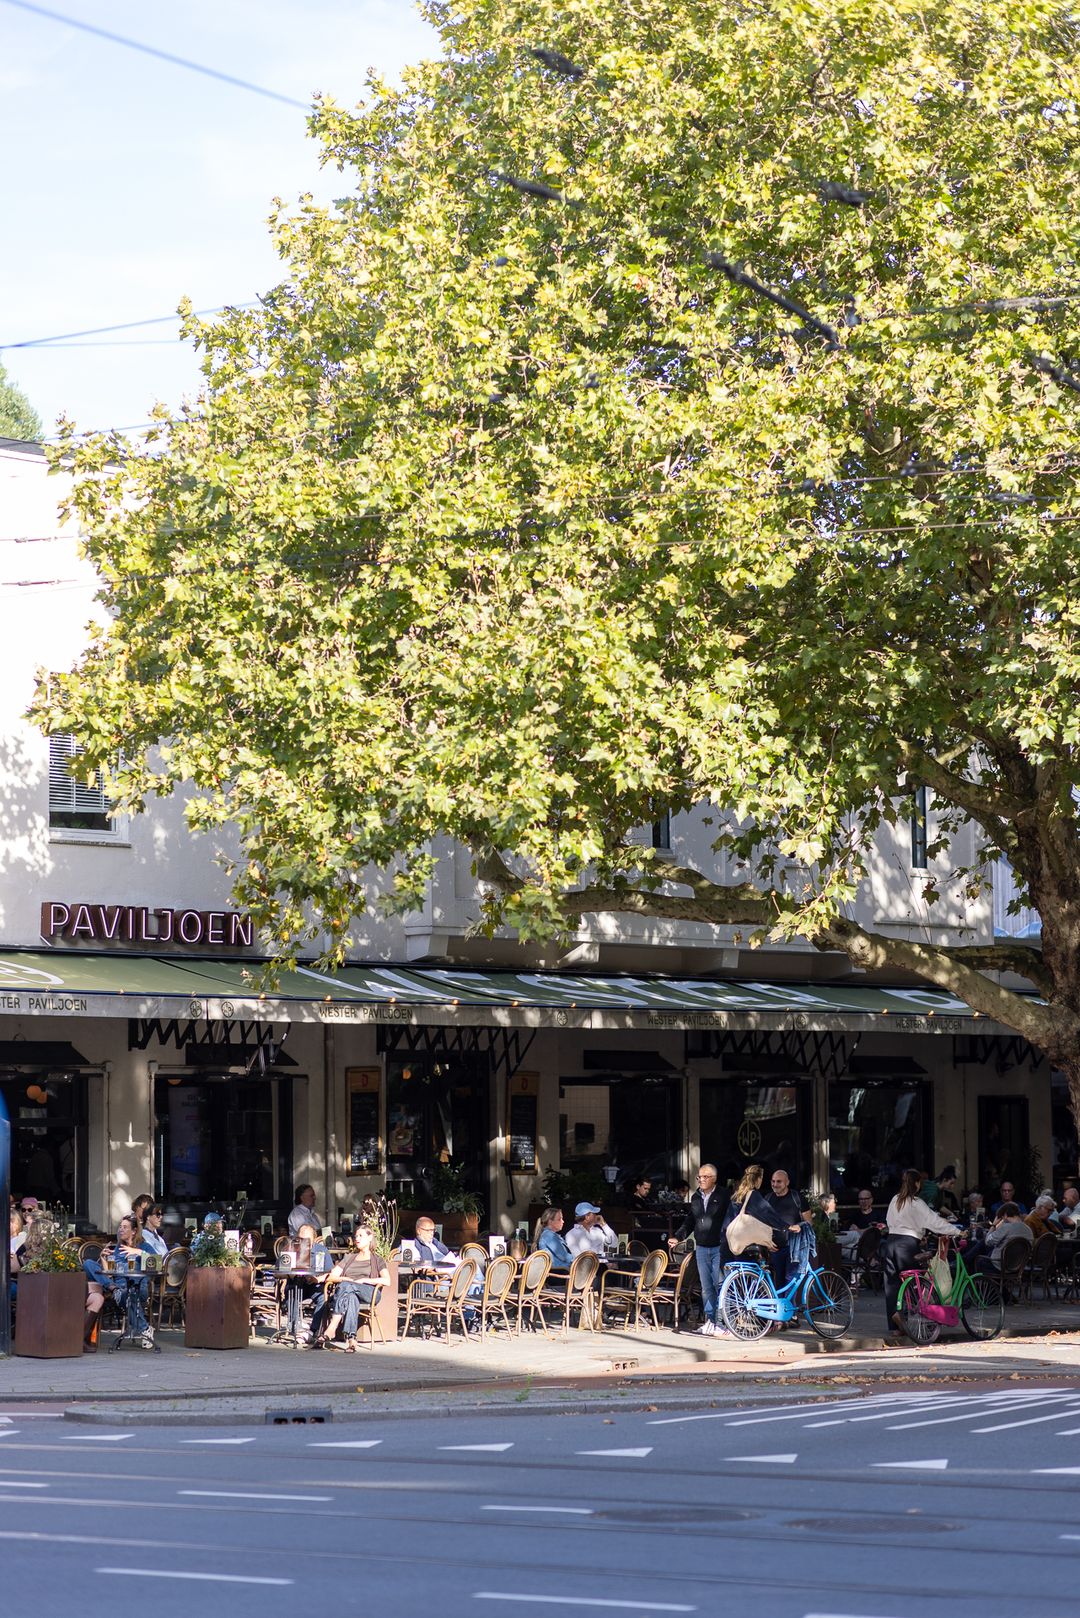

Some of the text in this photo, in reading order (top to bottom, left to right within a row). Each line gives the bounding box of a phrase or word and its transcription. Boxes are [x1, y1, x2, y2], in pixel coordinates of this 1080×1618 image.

[48, 902, 253, 946] PAVILJOEN
[0, 996, 88, 1012] TER PAVILJOEN
[319, 1007, 413, 1020] WESTER PAVILJOEN
[647, 1014, 725, 1026] WESTER PAVILJOEN
